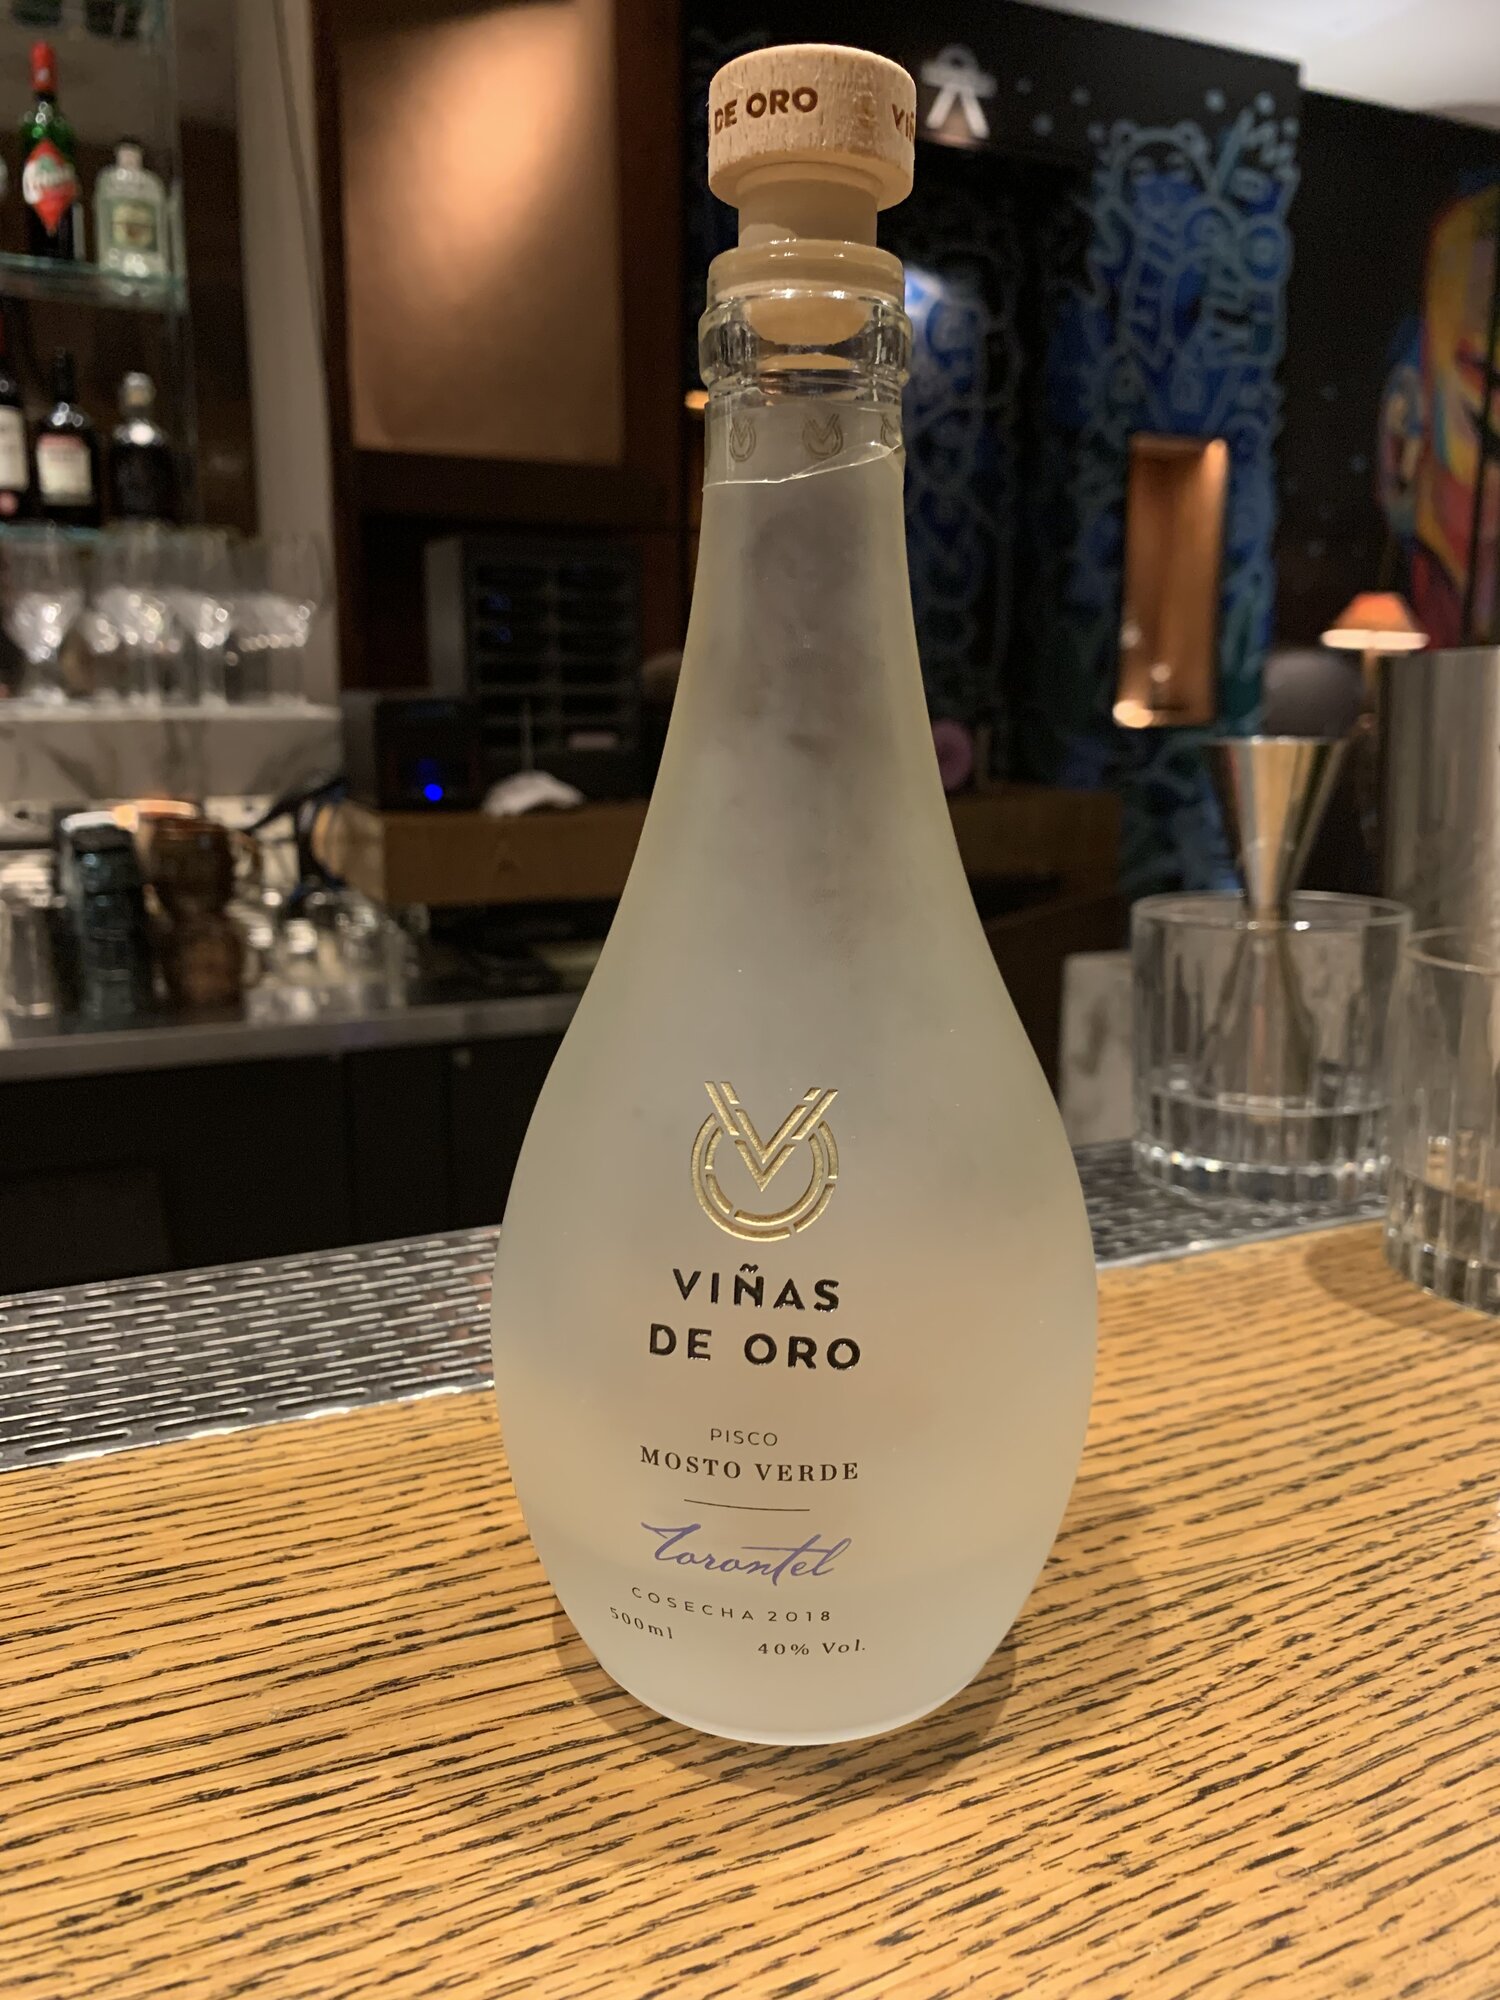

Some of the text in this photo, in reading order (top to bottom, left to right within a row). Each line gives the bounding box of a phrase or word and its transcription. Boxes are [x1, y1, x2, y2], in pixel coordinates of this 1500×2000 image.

[714, 87, 818, 135] DE ORO
[673, 1263, 840, 1312] VIÑAS
[650, 1323, 861, 1370] DE ORO
[710, 1428, 778, 1447] PISCO
[640, 1445, 859, 1482] MOSTO VERDE
[641, 1523, 852, 1587] Torontel
[631, 1586, 831, 1622] COSECHA 2018
[609, 1606, 674, 1640] 500ml
[757, 1639, 866, 1656] 40% Vol.
